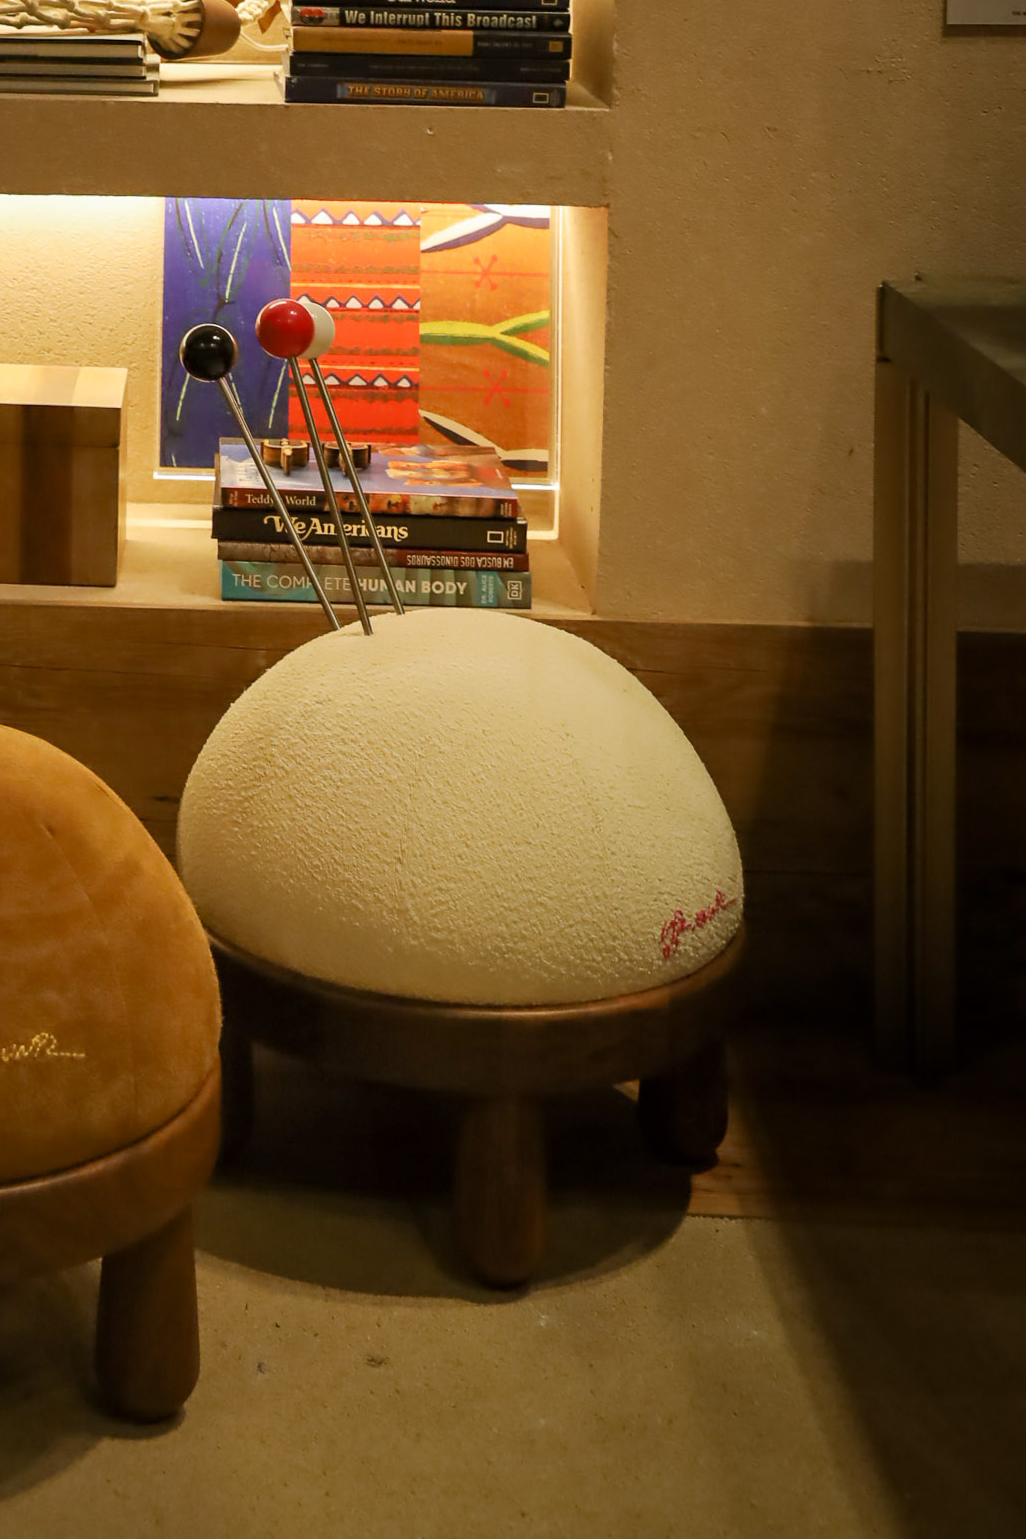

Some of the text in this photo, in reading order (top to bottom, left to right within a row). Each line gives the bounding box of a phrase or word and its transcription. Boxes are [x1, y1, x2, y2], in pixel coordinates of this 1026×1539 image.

[344, 10, 537, 29] We Interrupt This Broadcast
[348, 85, 369, 96] THE
[414, 87, 428, 98] OF
[431, 88, 484, 100] AMERICA
[285, 495, 316, 506] World
[461, 556, 475, 567] DOS
[476, 556, 502, 568] BUSCA
[503, 557, 514, 568] EM
[232, 573, 261, 588] THE
[266, 574, 351, 591] COMPETE
[421, 580, 467, 595] BODY
